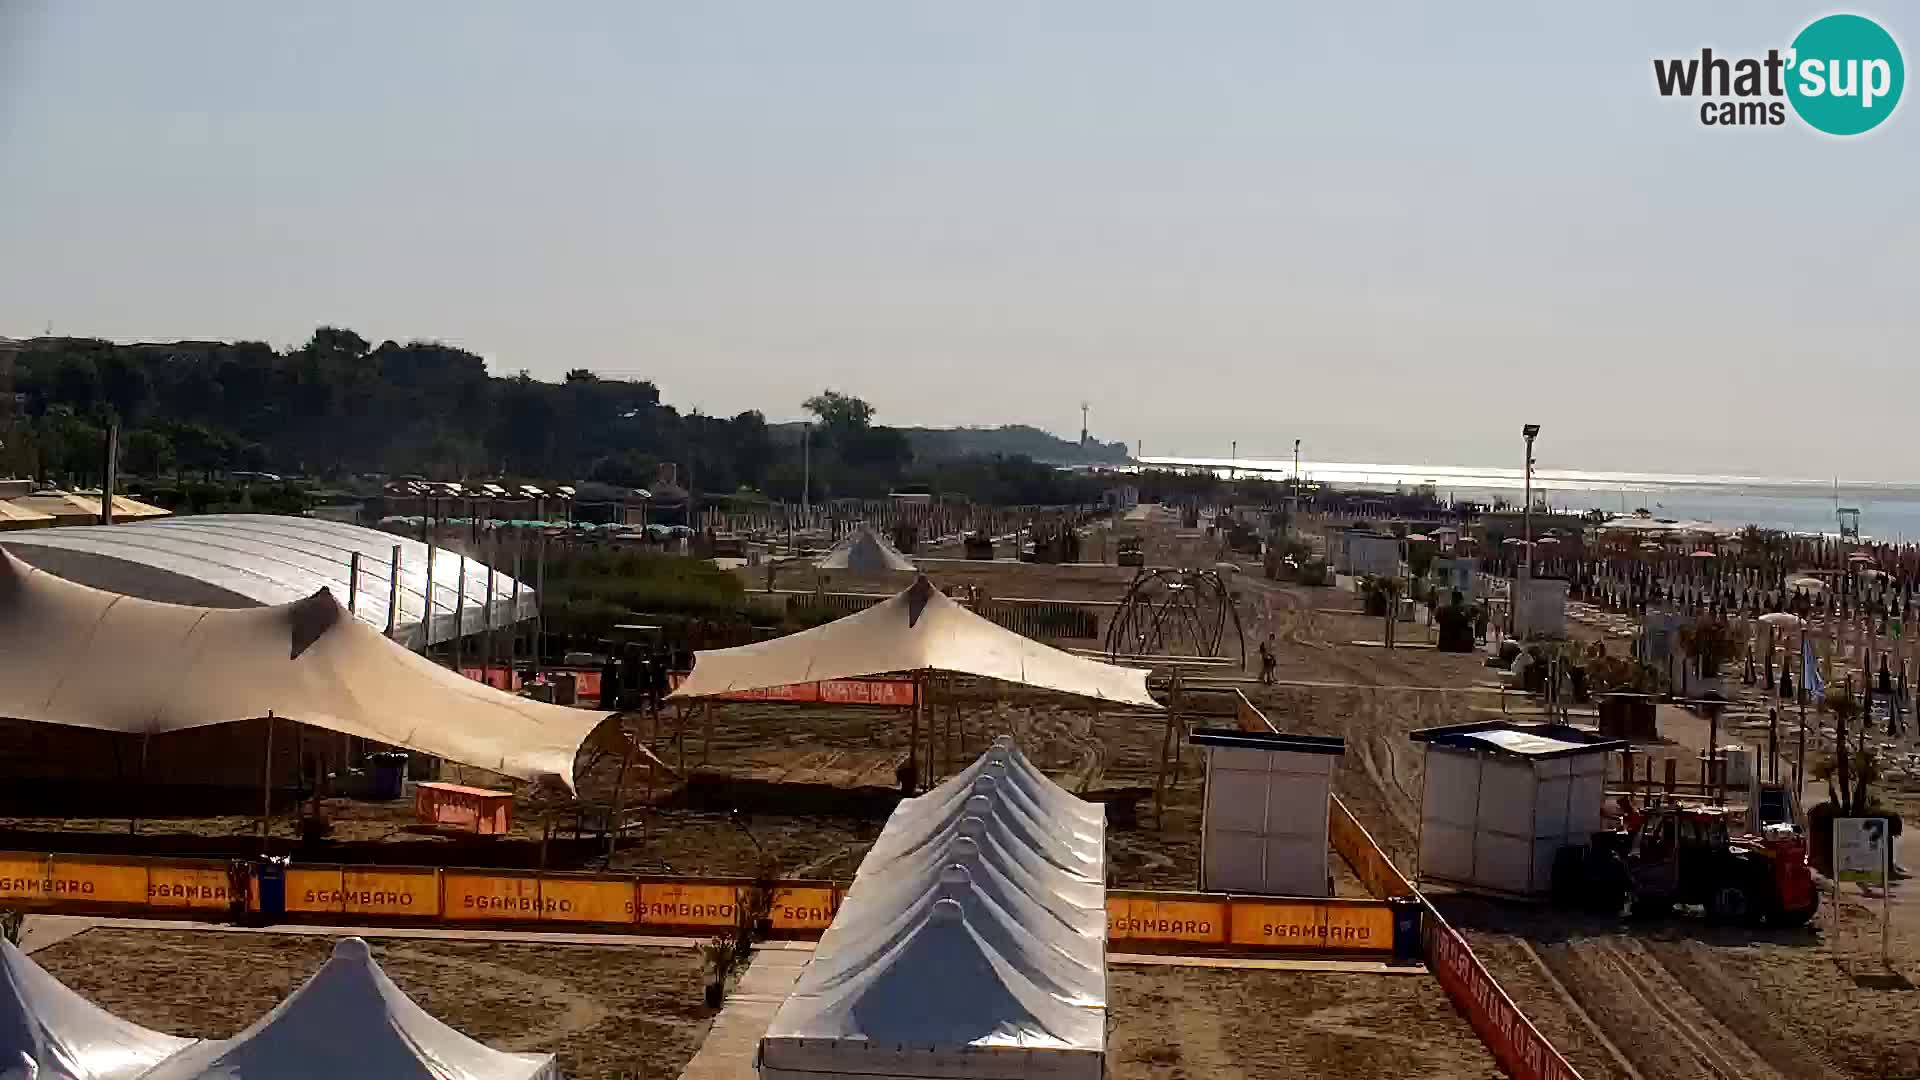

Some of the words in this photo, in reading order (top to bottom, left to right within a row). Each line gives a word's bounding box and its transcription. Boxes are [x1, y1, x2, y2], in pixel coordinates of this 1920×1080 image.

[148, 884, 227, 899] SGAMBA
[305, 889, 413, 906] SGAMBARO
[463, 894, 572, 913] SGAMBARO
[625, 901, 732, 918] SGAMBARO
[1263, 923, 1370, 940] SGAMBARO
